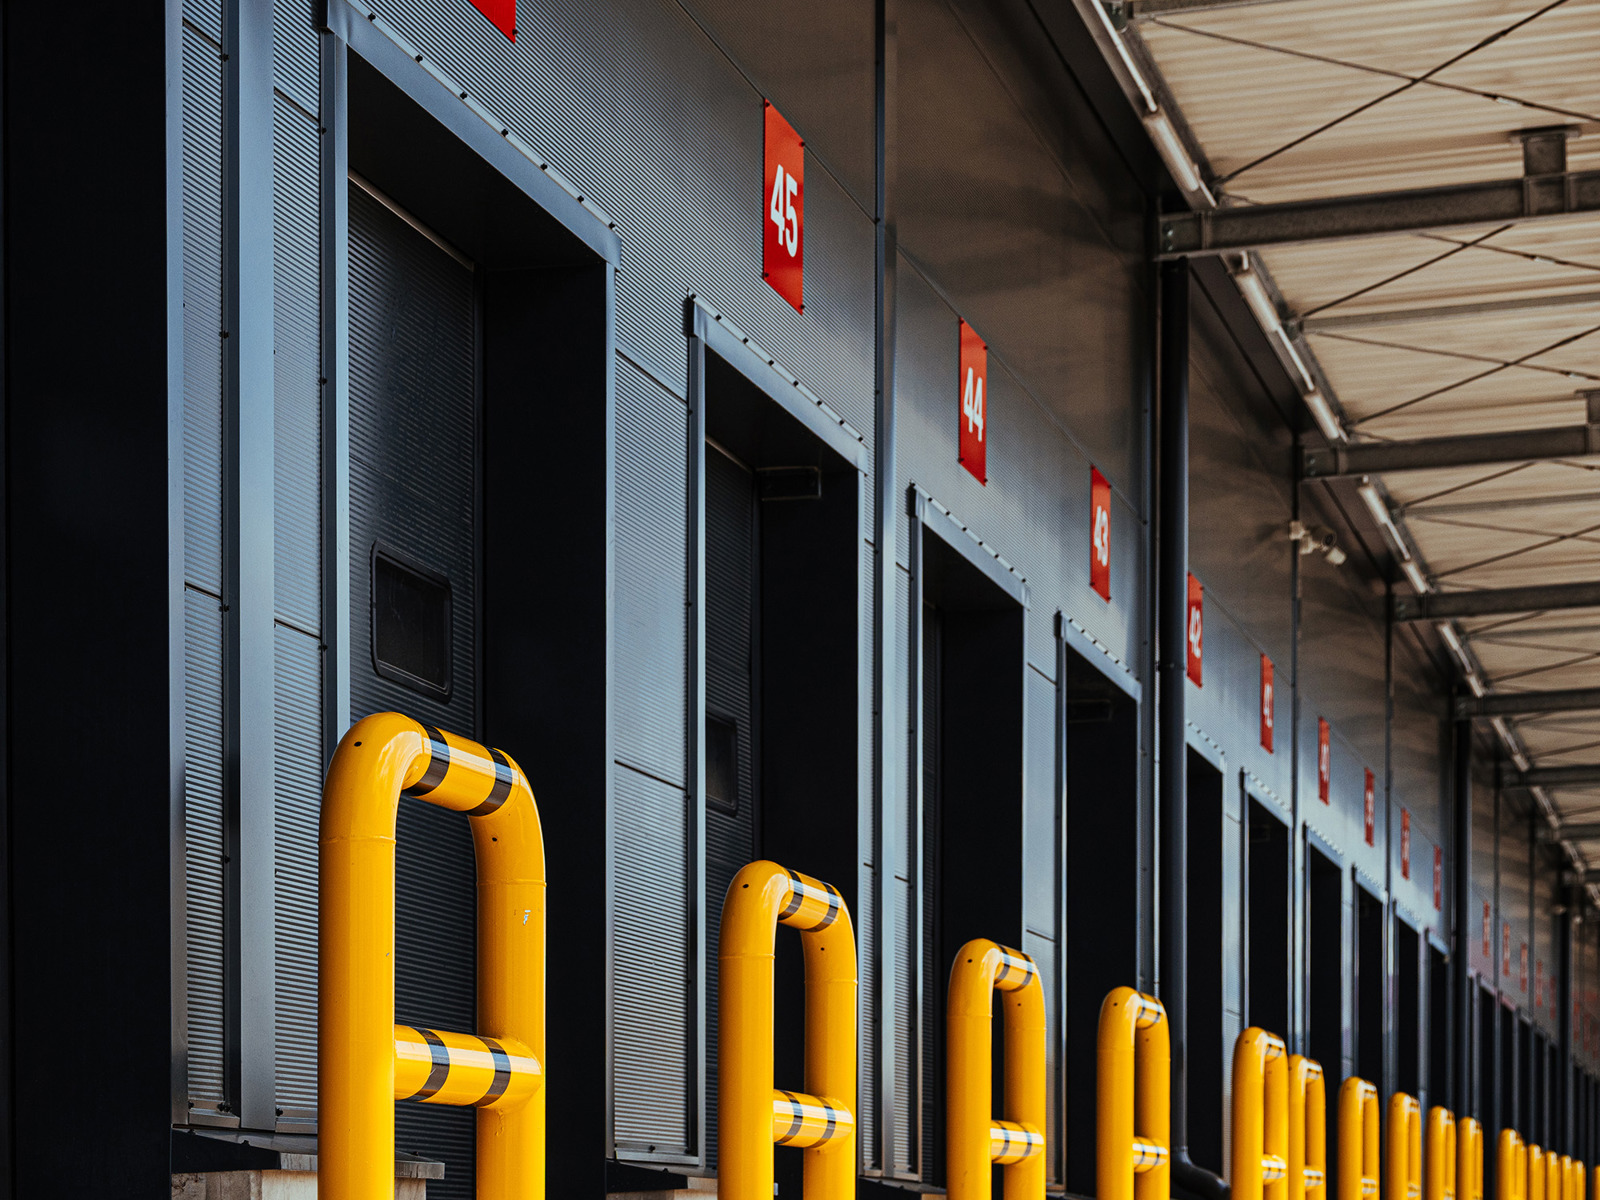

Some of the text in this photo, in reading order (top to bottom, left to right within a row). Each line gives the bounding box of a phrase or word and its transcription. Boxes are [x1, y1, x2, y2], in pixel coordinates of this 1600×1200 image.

[770, 164, 798, 258] 45
[964, 367, 984, 443] 44
[1093, 505, 1110, 567] 43
[1189, 606, 1202, 659] 42
